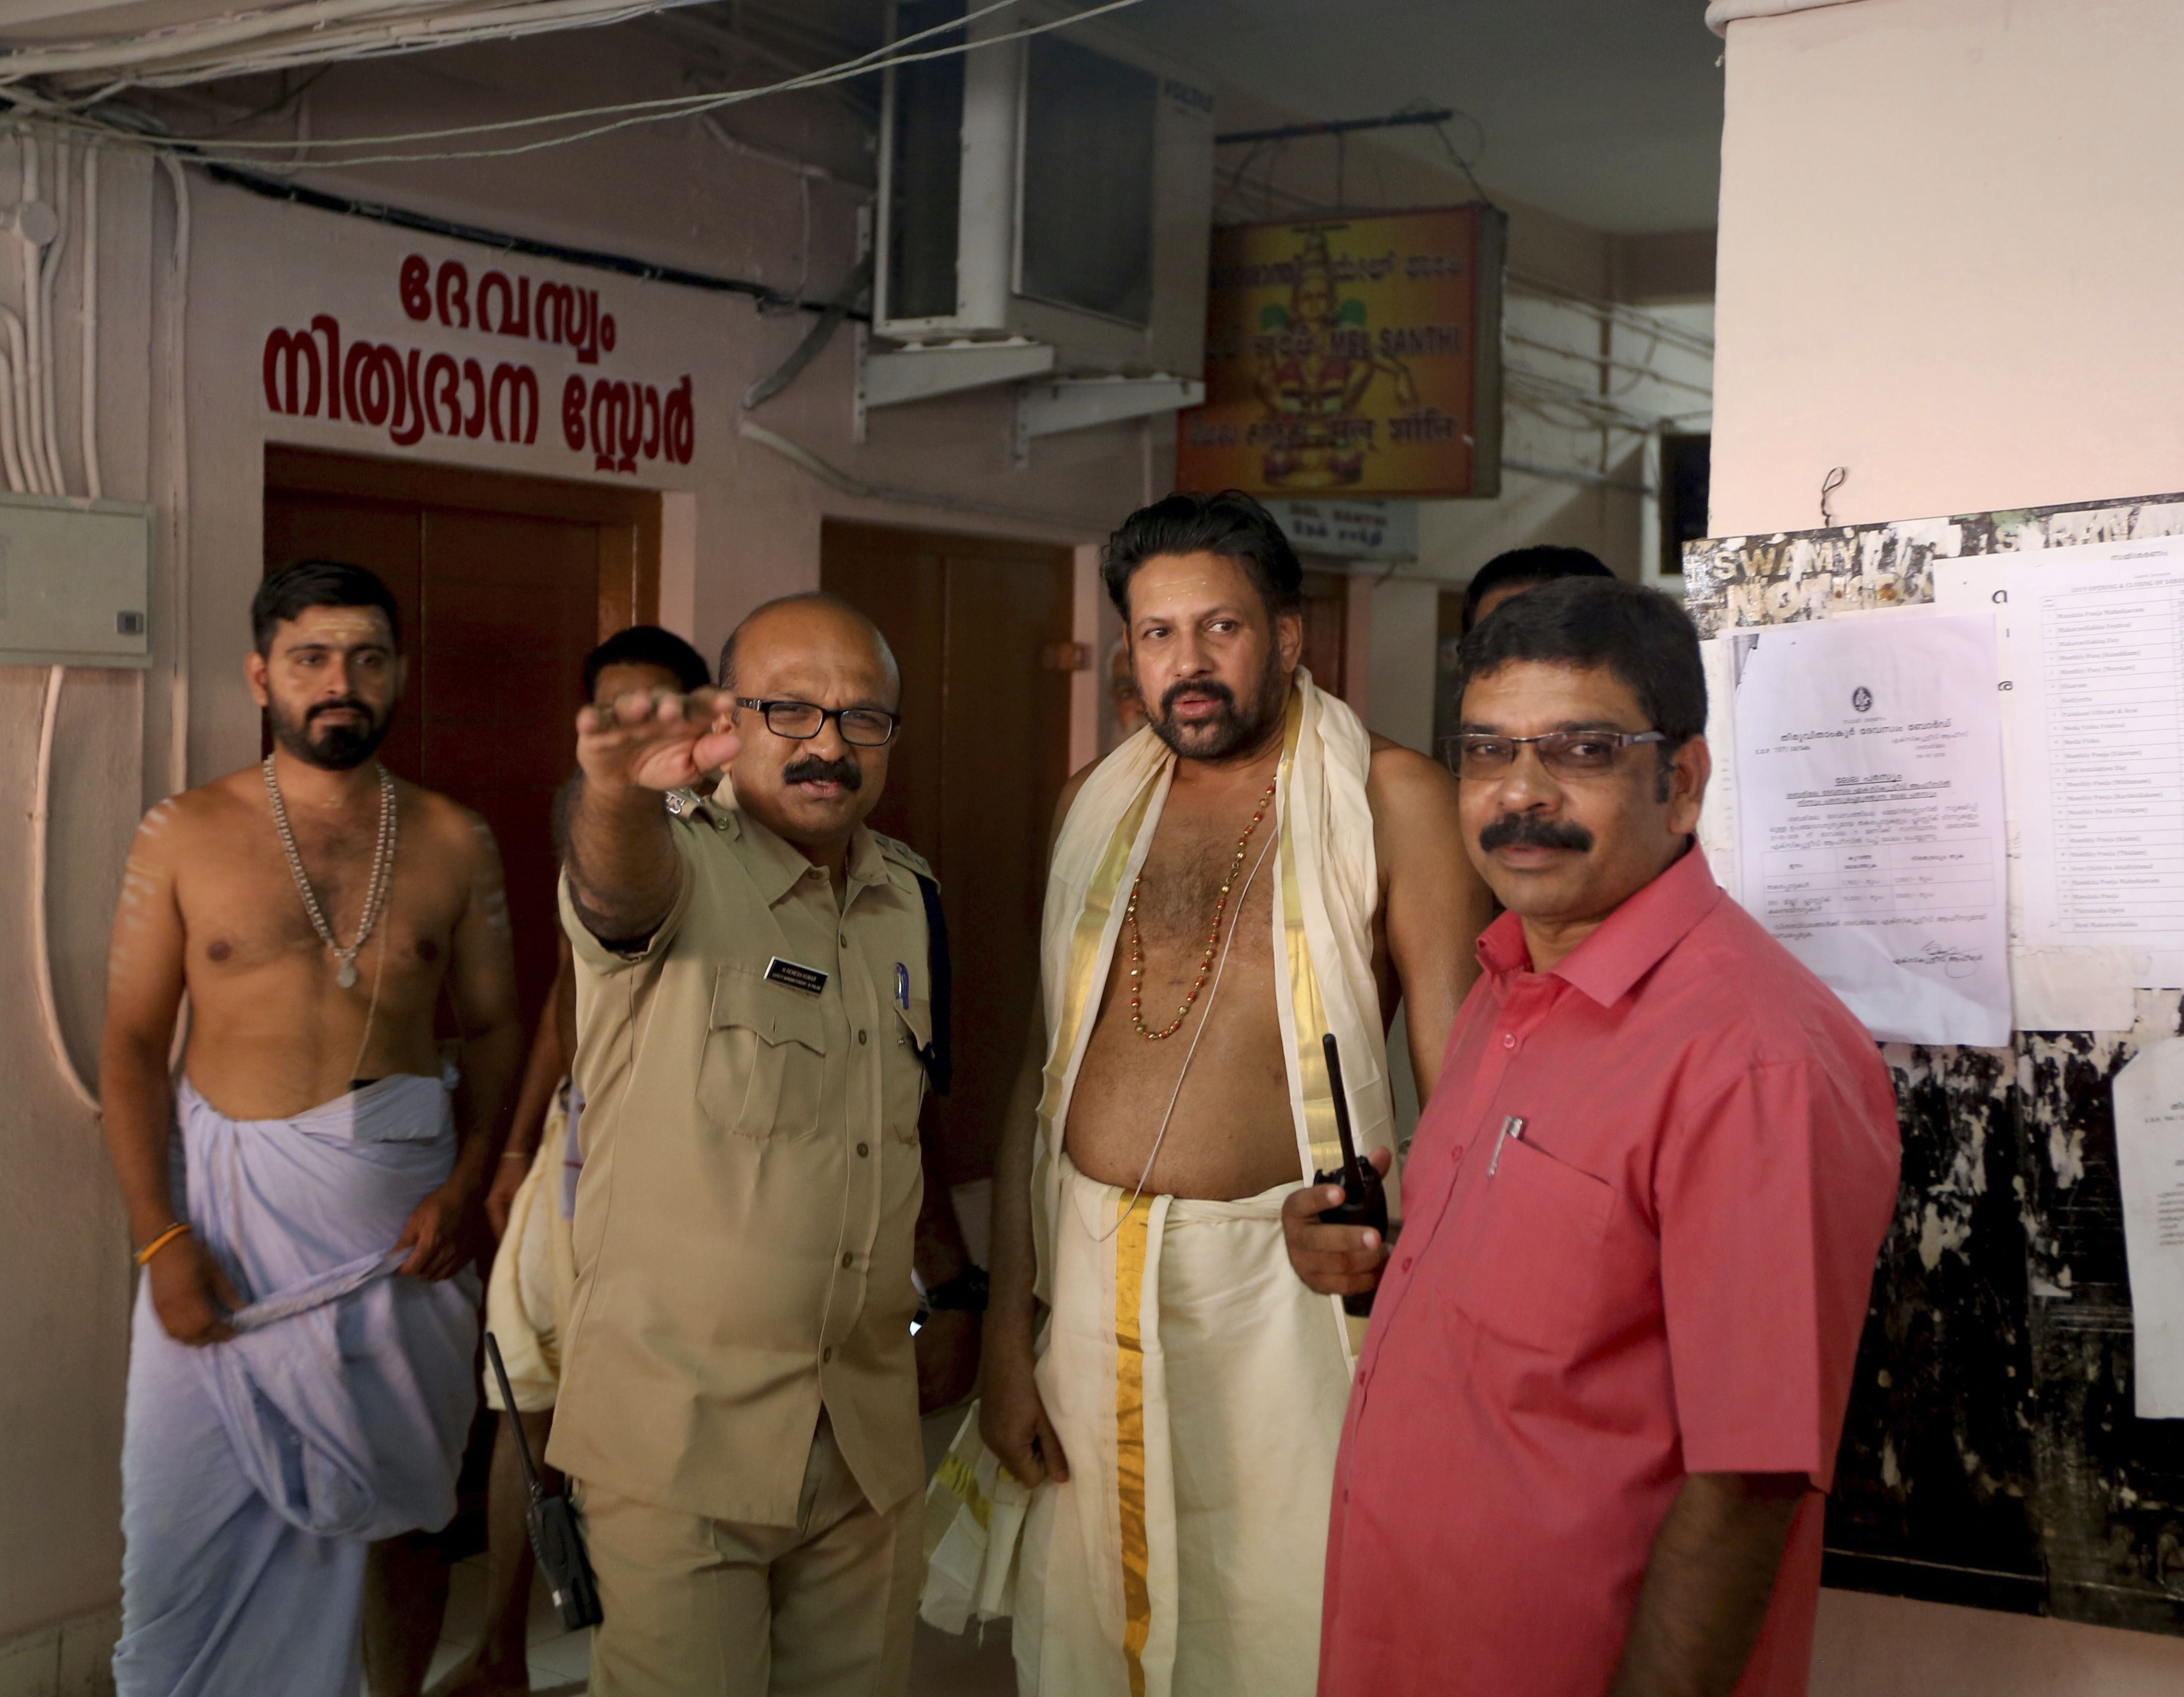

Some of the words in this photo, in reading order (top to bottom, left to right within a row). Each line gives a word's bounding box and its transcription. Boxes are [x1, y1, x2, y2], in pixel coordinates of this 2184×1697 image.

[400, 254, 615, 365] ദേവസ്വം
[263, 314, 539, 446] നിത്യദാന
[562, 374, 694, 474] സ്റ്റോർ
[1714, 538, 1859, 580] SWAMY
[1780, 726, 1855, 743] തിരുവിതാംകൂർ
